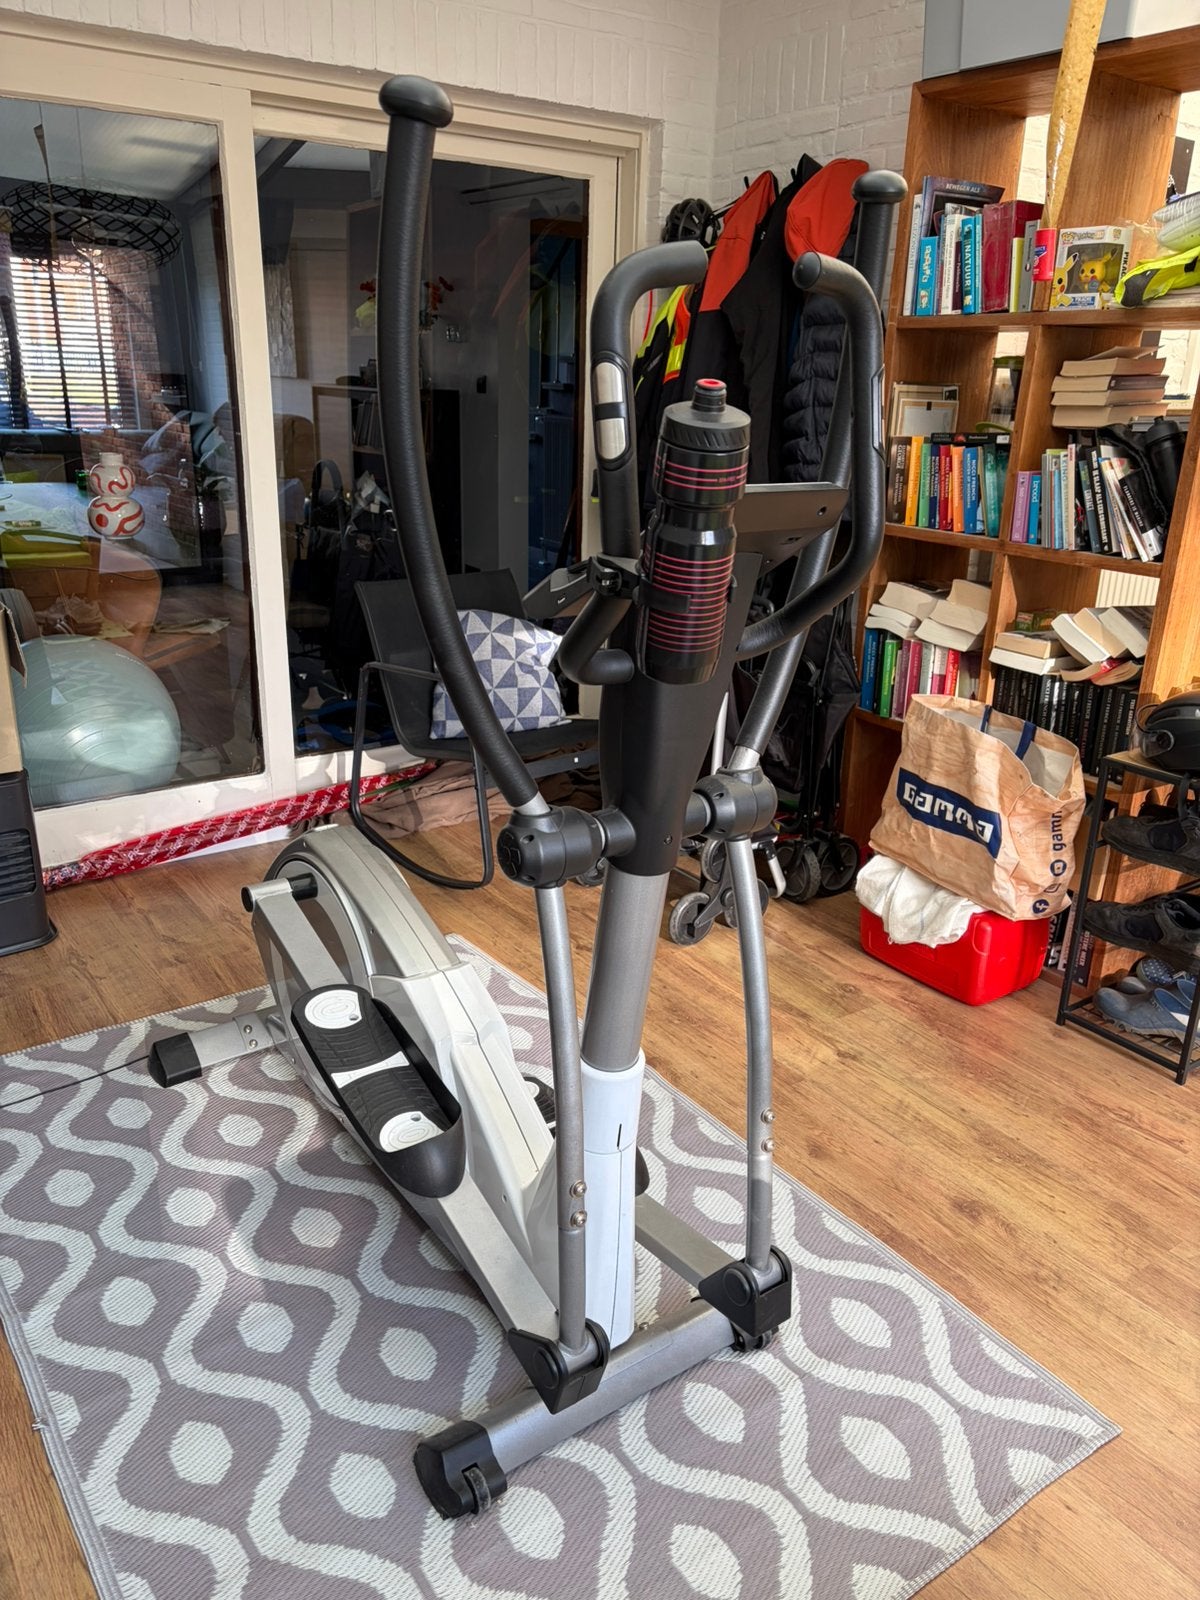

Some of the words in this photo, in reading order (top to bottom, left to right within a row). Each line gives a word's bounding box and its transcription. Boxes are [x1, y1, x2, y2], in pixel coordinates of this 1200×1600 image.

[963, 244, 972, 287] NATUUR
[1031, 480, 1040, 503] brood
[1084, 489, 1094, 511] CONTACT
[1092, 476, 1101, 494] SLAAP
[1098, 514, 1108, 544] CROISSANT
